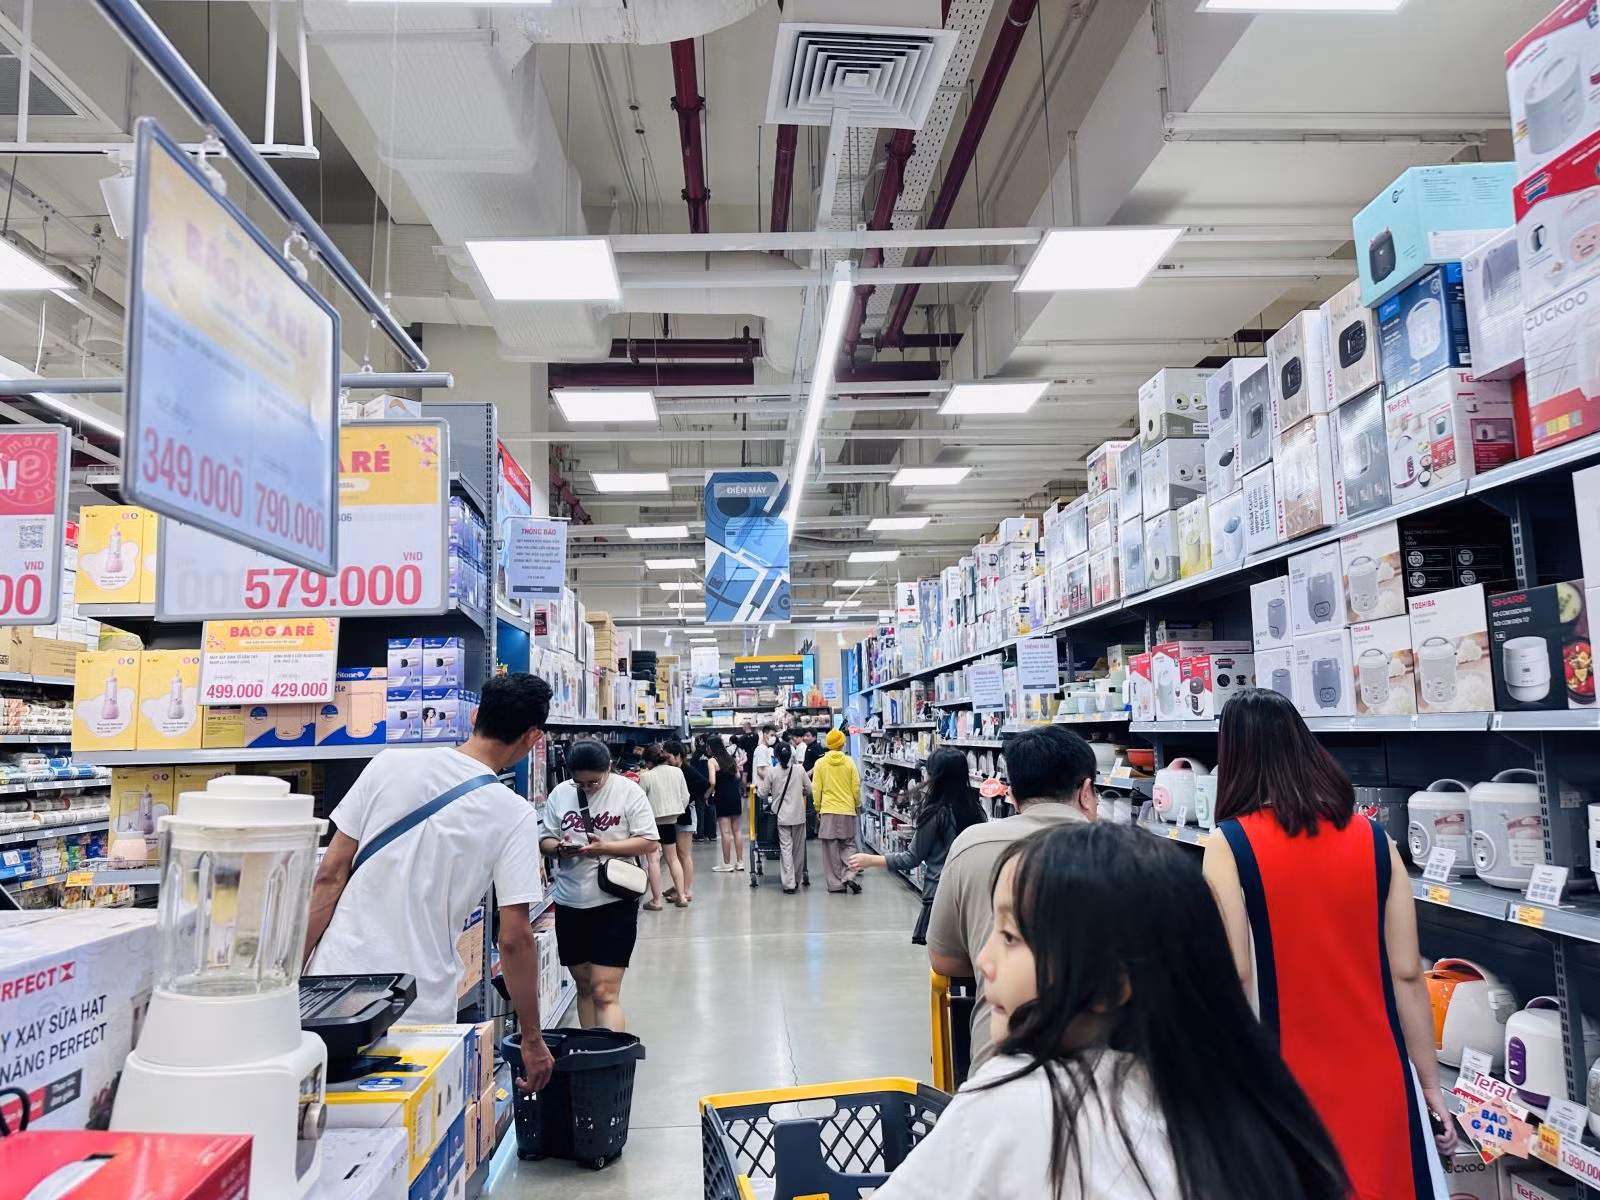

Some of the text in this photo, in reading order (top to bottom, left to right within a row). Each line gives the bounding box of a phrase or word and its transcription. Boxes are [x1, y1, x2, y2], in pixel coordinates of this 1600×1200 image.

[1525, 291, 1588, 331] CUCKOO
[1387, 396, 1410, 413] Tefal
[142, 426, 325, 552] 349.000 790.000
[726, 485, 767, 496] ĐIỆN MÁY
[1336, 480, 1345, 515] Tefal
[25, 561, 44, 571] VND
[403, 552, 423, 561] VND
[244, 564, 422, 609] 579.000
[1411, 599, 1436, 610] TOSHIBA
[1491, 594, 1527, 607] SHARP
[1353, 625, 1371, 633] TOSHIBA
[206, 682, 328, 698] 499.000 429.000
[0, 967, 57, 1001] RFECT
[15, 1019, 46, 1049] XAY
[49, 1006, 78, 1035] SỮA
[81, 994, 107, 1021] HẠT
[50, 1022, 107, 1065] PERFECT
[1473, 1071, 1513, 1102] Tefal
[1443, 1162, 1486, 1174] UCKOO
[1562, 1151, 1600, 1180] 1.990.00
